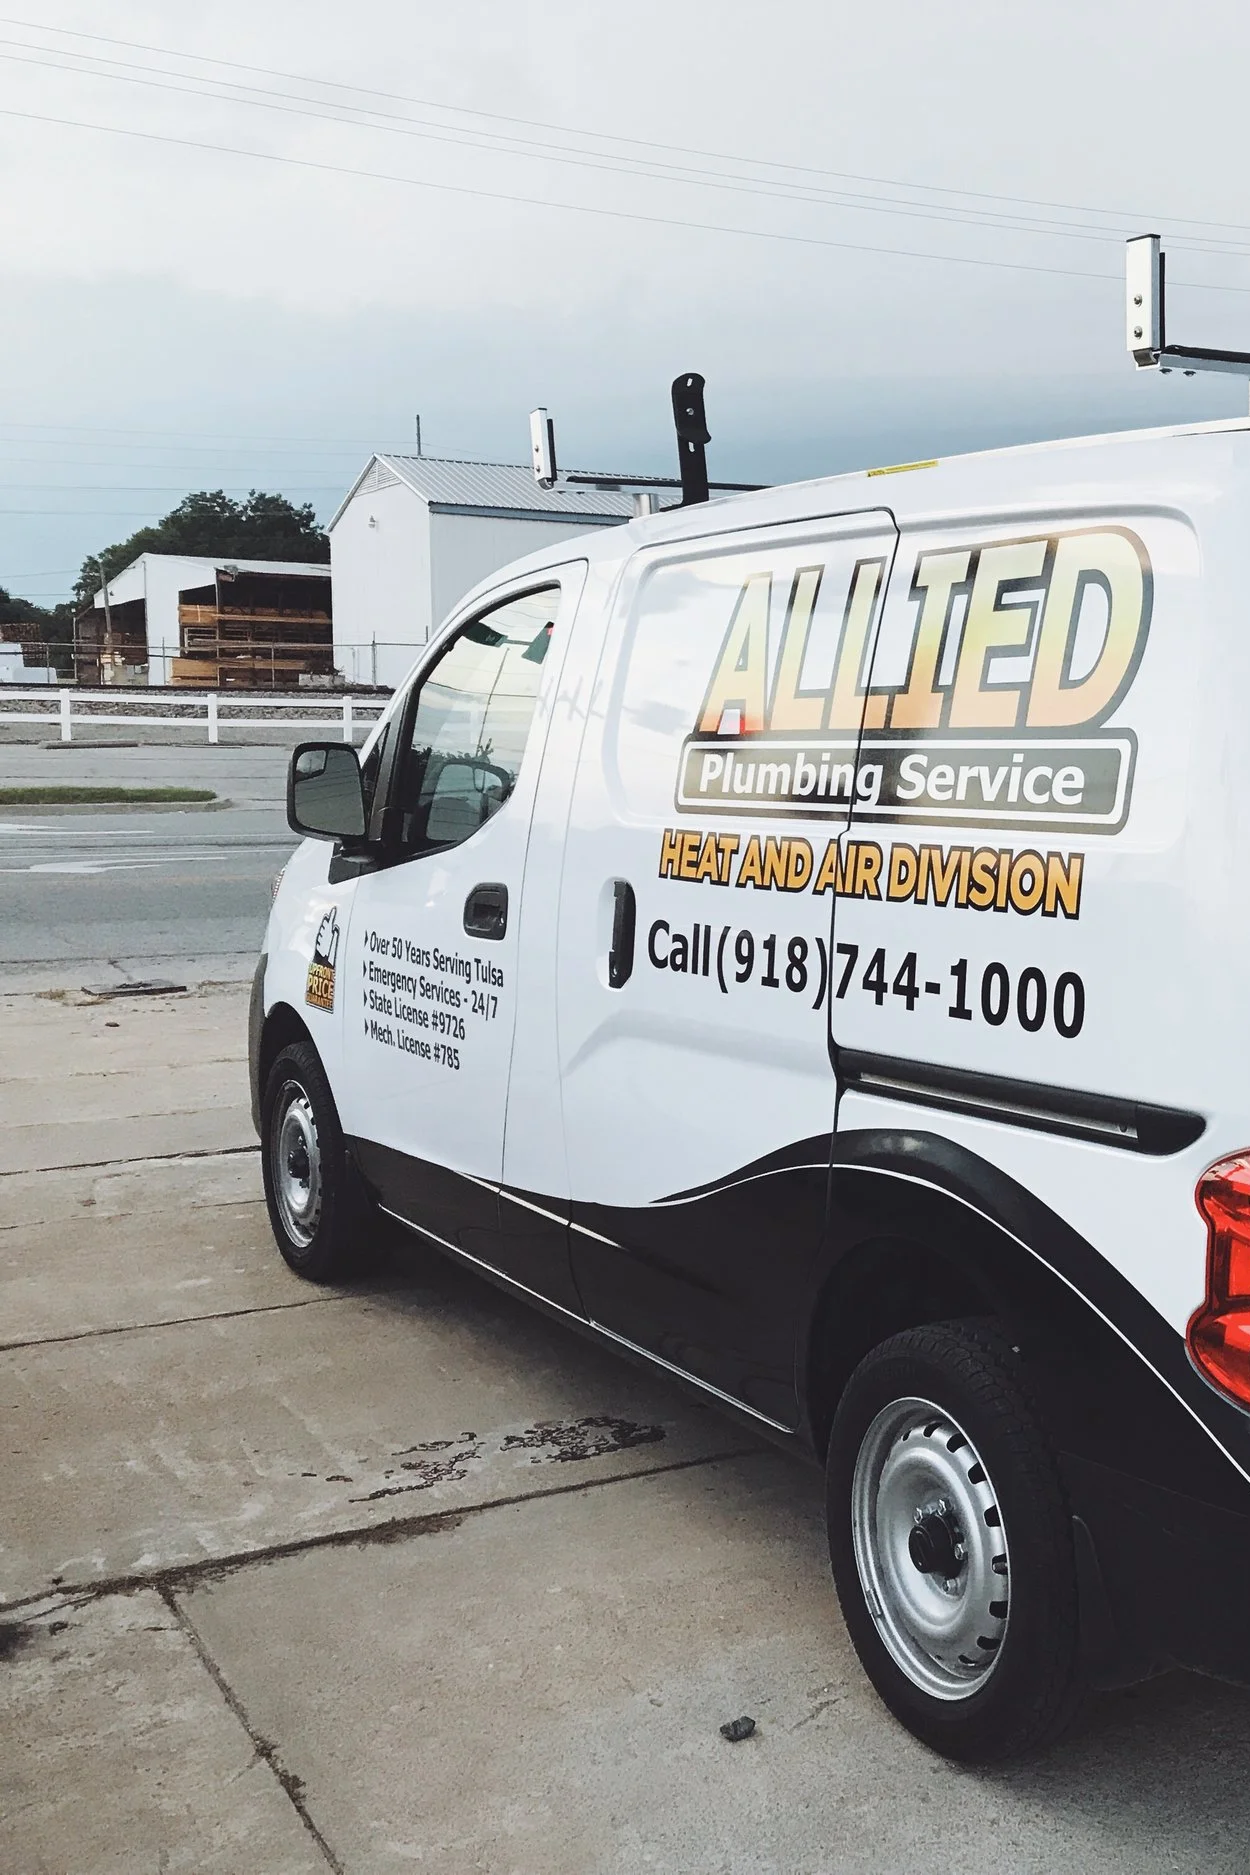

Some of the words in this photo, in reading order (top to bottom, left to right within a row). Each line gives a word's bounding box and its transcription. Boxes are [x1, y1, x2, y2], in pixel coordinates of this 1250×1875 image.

[696, 525, 1154, 736] ALLIED
[699, 752, 883, 805] Plumbing
[896, 753, 1085, 806] Service
[659, 828, 739, 882] HEAT
[736, 834, 813, 894] AND
[812, 838, 883, 900] AIR
[885, 842, 1086, 920] DIVISION
[307, 974, 335, 1000] PRICE
[369, 931, 390, 954] Over
[392, 938, 402, 960] 50
[404, 940, 430, 968] Years
[433, 948, 472, 984] Serving
[474, 958, 504, 988] Tulsa
[369, 961, 417, 1000] Emergency
[419, 976, 461, 1008] Services
[471, 990, 498, 1021] 24/7
[369, 989, 393, 1016] State
[395, 996, 429, 1028] License
[432, 1010, 466, 1040] #9726
[370, 1019, 395, 1046] Mech.
[397, 1029, 431, 1060] License
[434, 1043, 460, 1070] #785
